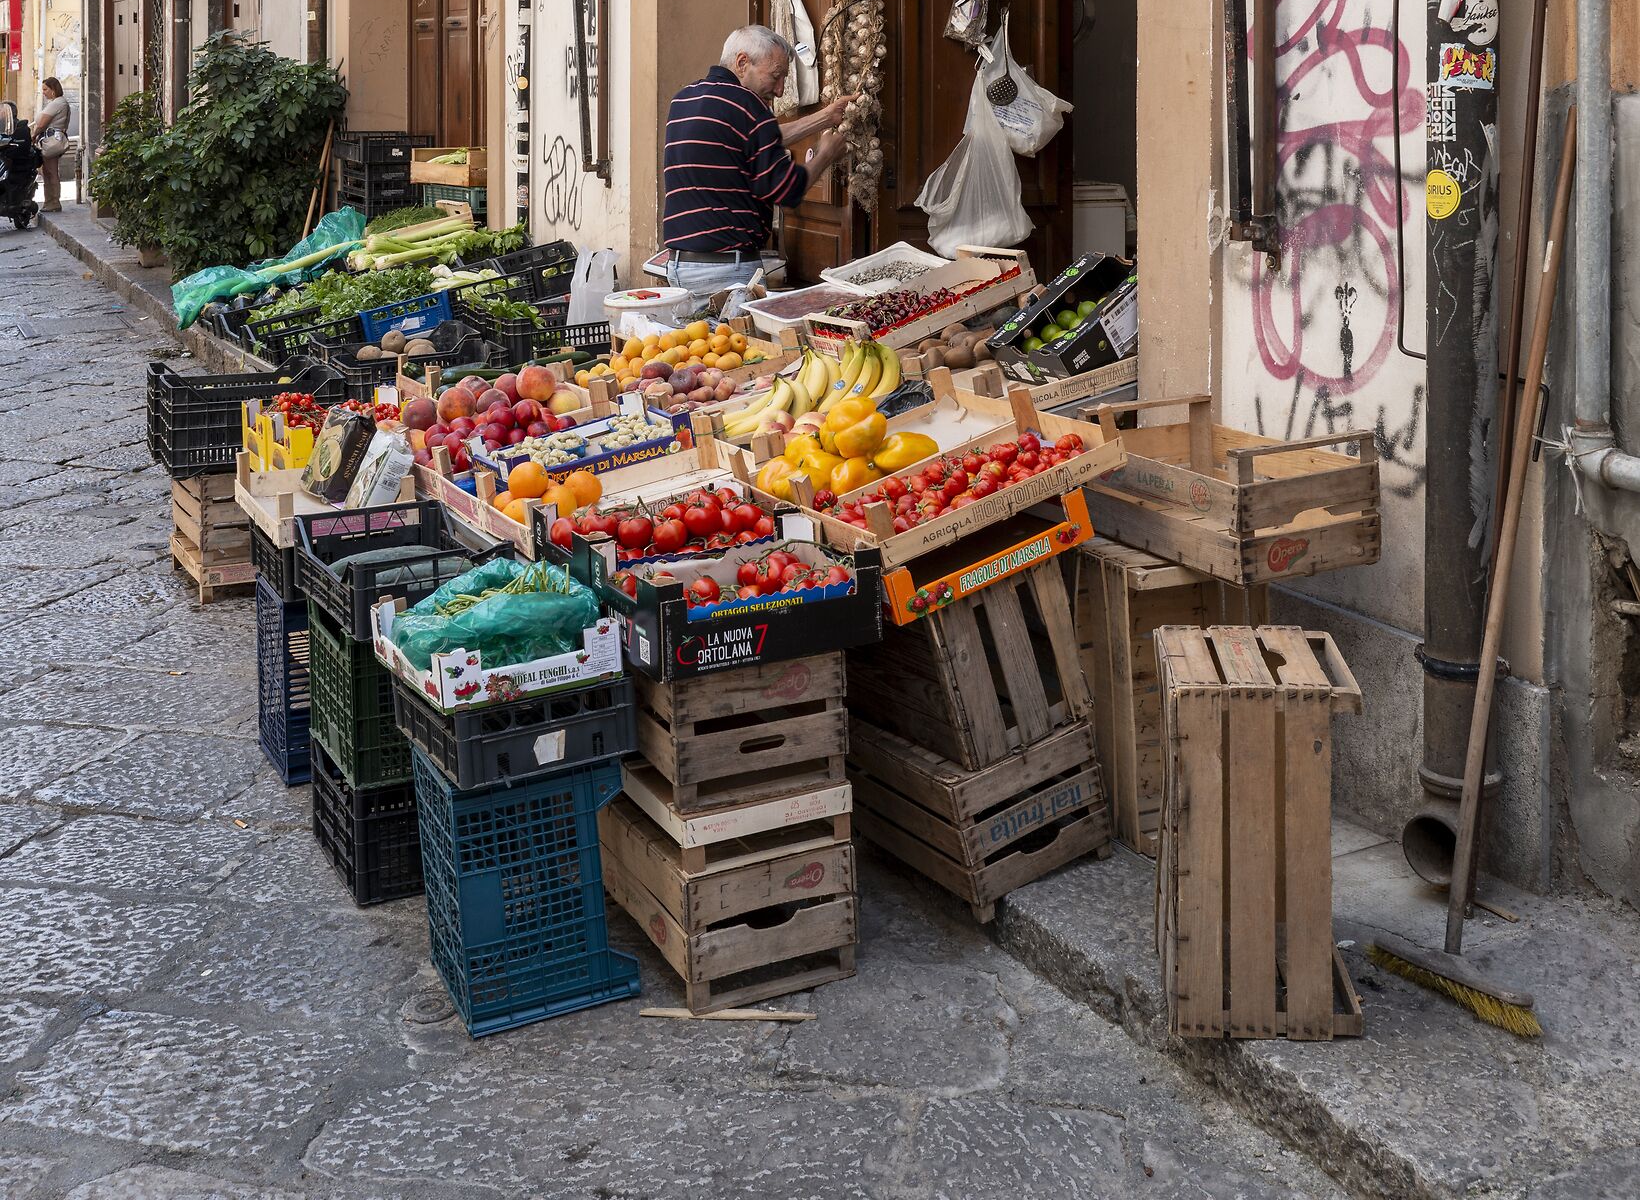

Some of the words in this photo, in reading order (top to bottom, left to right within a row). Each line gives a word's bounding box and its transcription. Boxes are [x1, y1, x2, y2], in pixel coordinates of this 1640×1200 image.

[1428, 184, 1452, 195] SIRIUS
[598, 460, 610, 471] DI
[922, 518, 972, 544] AGRICOLA
[972, 466, 1074, 523] HORTOITALIA
[959, 562, 999, 592] FRAGOLE
[999, 558, 1010, 575] DI
[1010, 537, 1052, 570] MARSALA
[711, 606, 748, 618] ORTAGGI
[750, 596, 804, 613] SELEZIONATI
[708, 632, 720, 647] LA
[723, 626, 753, 644] NUOVA
[754, 624, 769, 656] 7
[698, 642, 752, 665] ORTOLANA
[539, 664, 568, 680] FUNGHI
